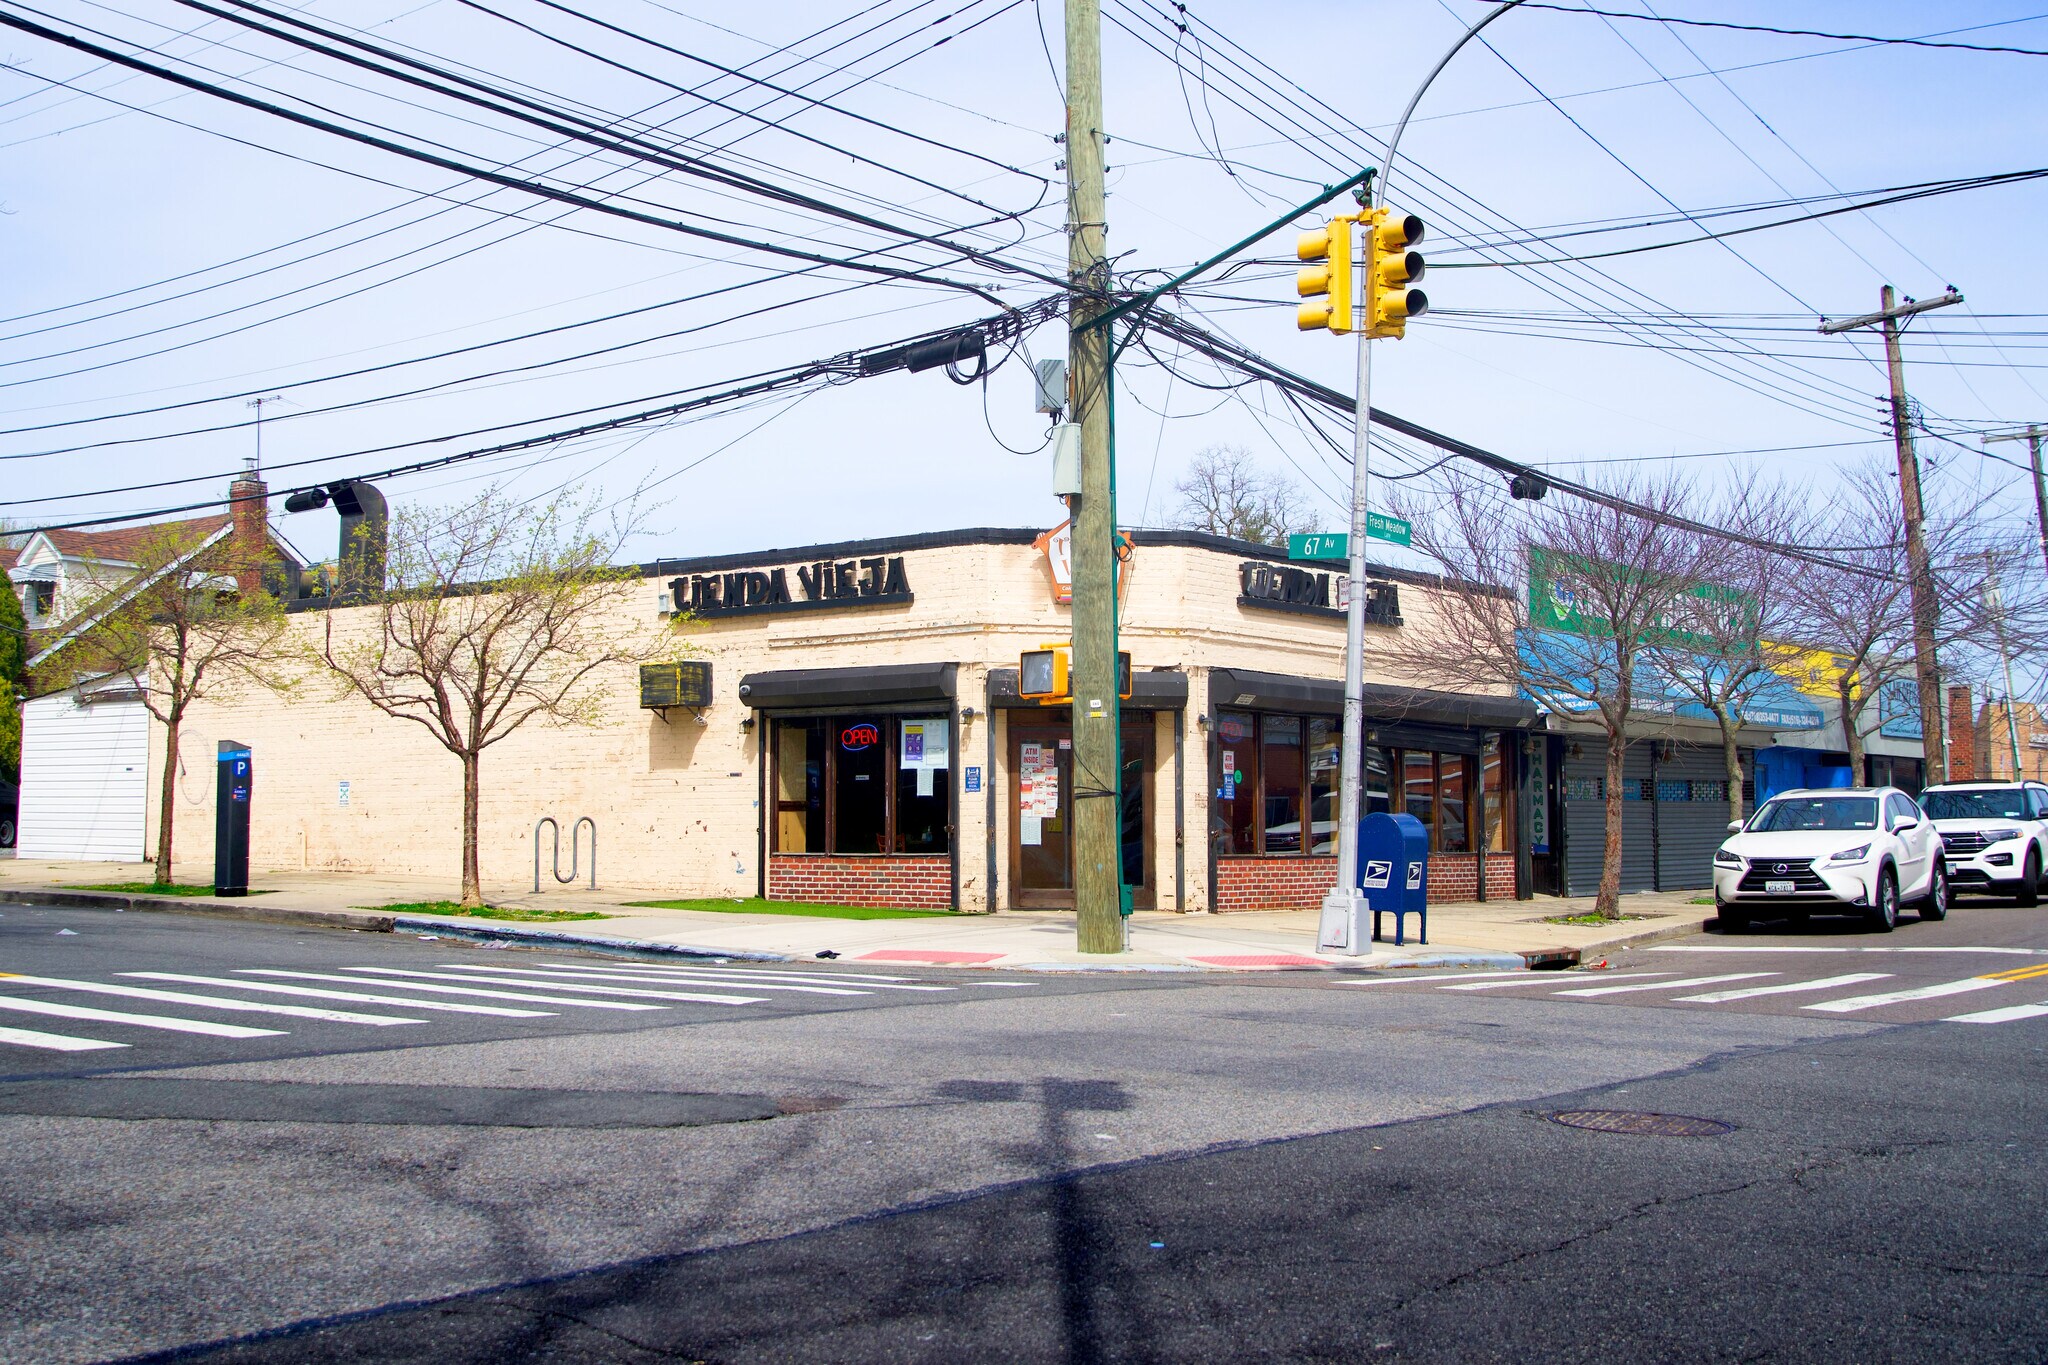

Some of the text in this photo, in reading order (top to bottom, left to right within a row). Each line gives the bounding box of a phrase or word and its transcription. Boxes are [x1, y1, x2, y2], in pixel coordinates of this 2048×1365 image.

[1370, 514, 1406, 535] Fresh Meadow
[1304, 538, 1334, 556] 67 Av
[842, 729, 878, 745] OPEN
[238, 762, 246, 774] P
[1532, 740, 1544, 844] PHARMACY
